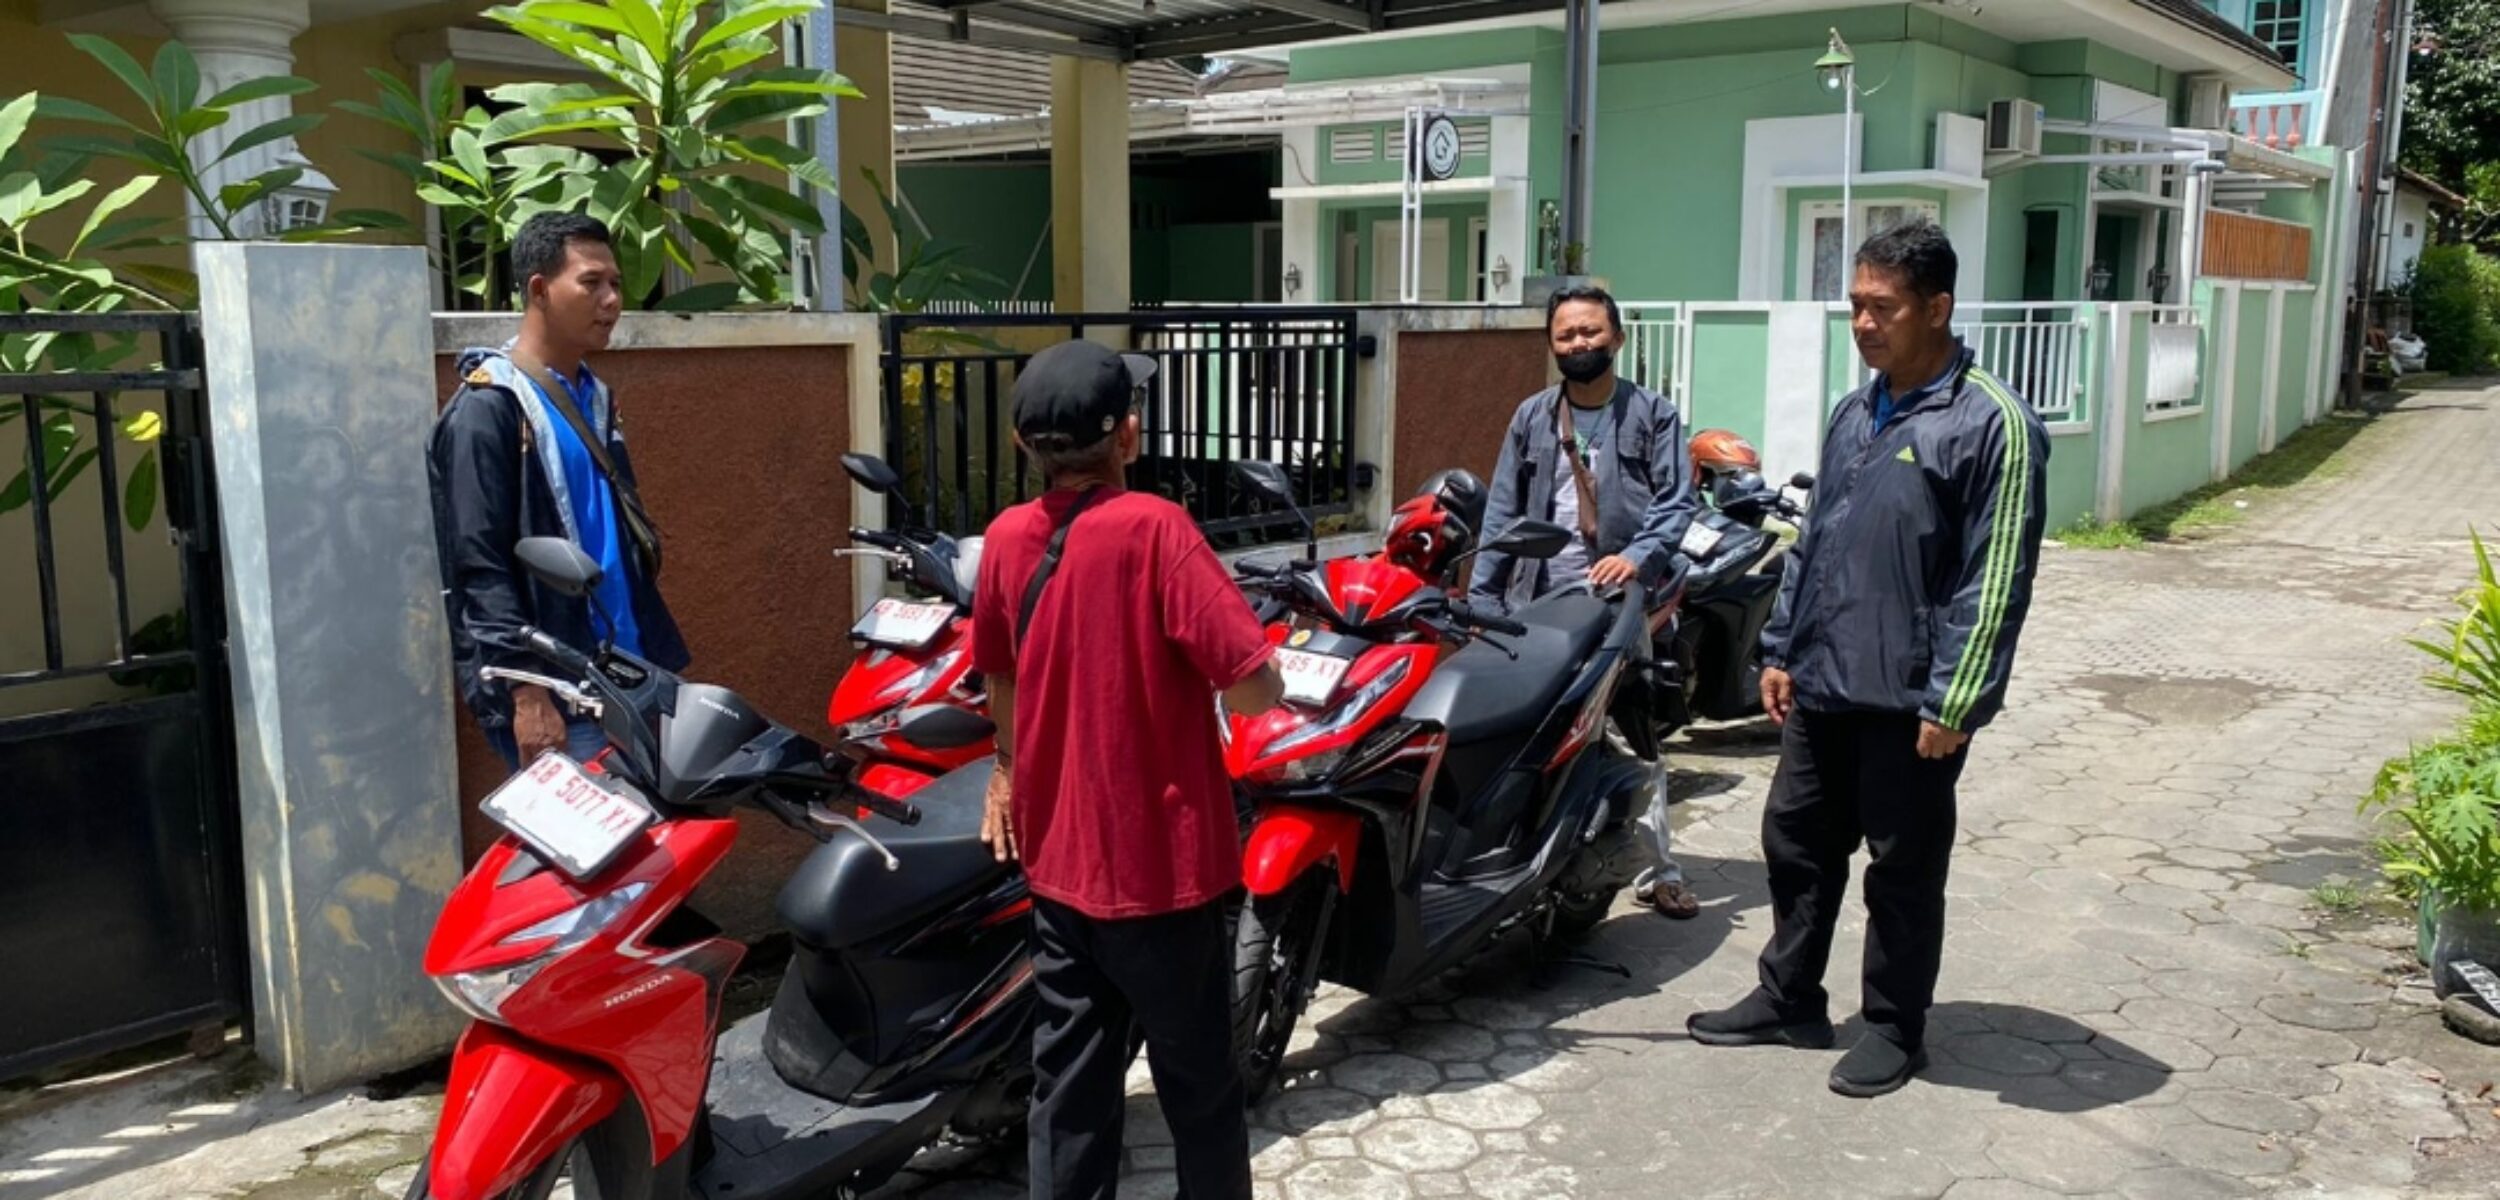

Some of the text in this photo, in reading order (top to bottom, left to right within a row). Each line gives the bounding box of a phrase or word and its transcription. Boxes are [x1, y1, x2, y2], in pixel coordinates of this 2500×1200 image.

[698, 695, 740, 720] HONDA
[527, 756, 564, 785] AB
[555, 775, 610, 817] 5077
[603, 974, 673, 1009] HONDA
